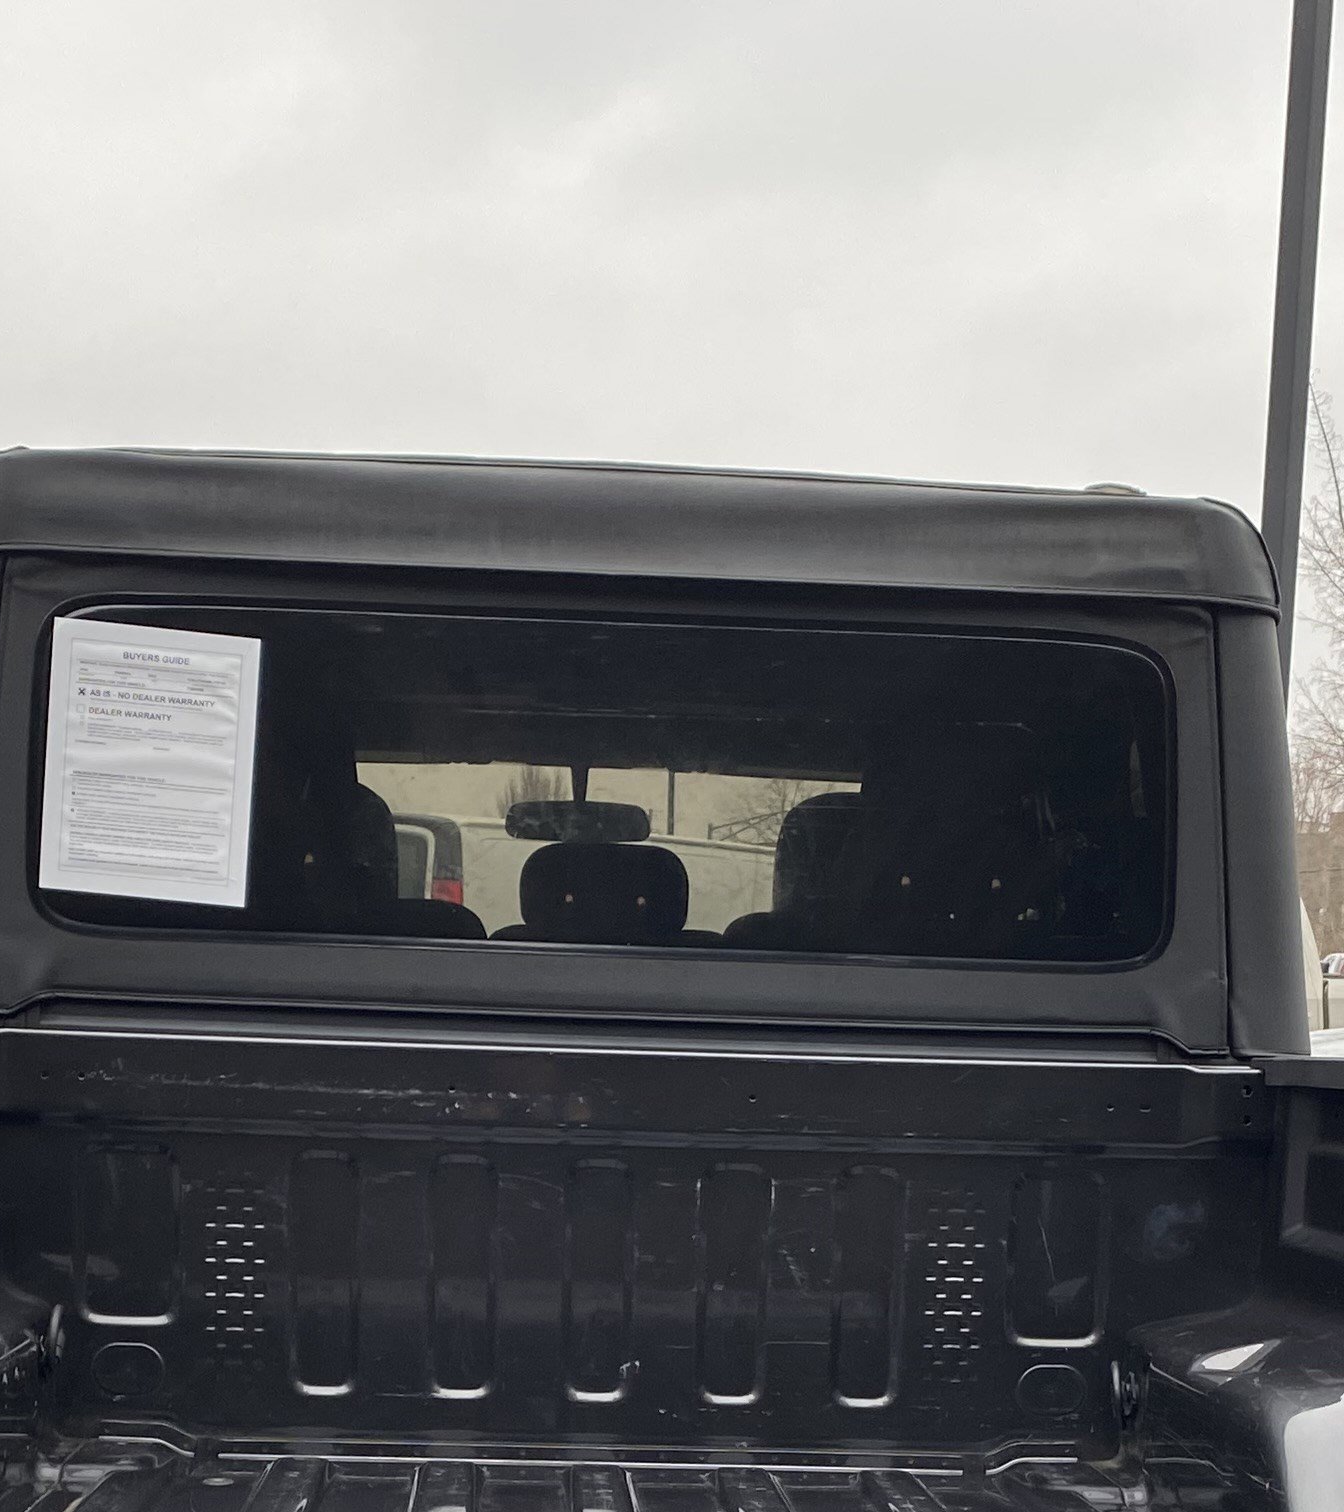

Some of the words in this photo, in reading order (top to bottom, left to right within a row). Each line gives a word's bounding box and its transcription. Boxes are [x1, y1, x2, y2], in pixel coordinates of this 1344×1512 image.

[122, 651, 160, 663] BUYERS
[162, 655, 190, 666] GUIDE
[89, 689, 101, 697] AS
[102, 690, 111, 698] IS
[117, 691, 131, 700] NO
[132, 692, 166, 704] DEALER
[167, 695, 215, 708] WARRANTY
[88, 706, 122, 717] DEALER
[124, 710, 172, 721] WARRANTY
